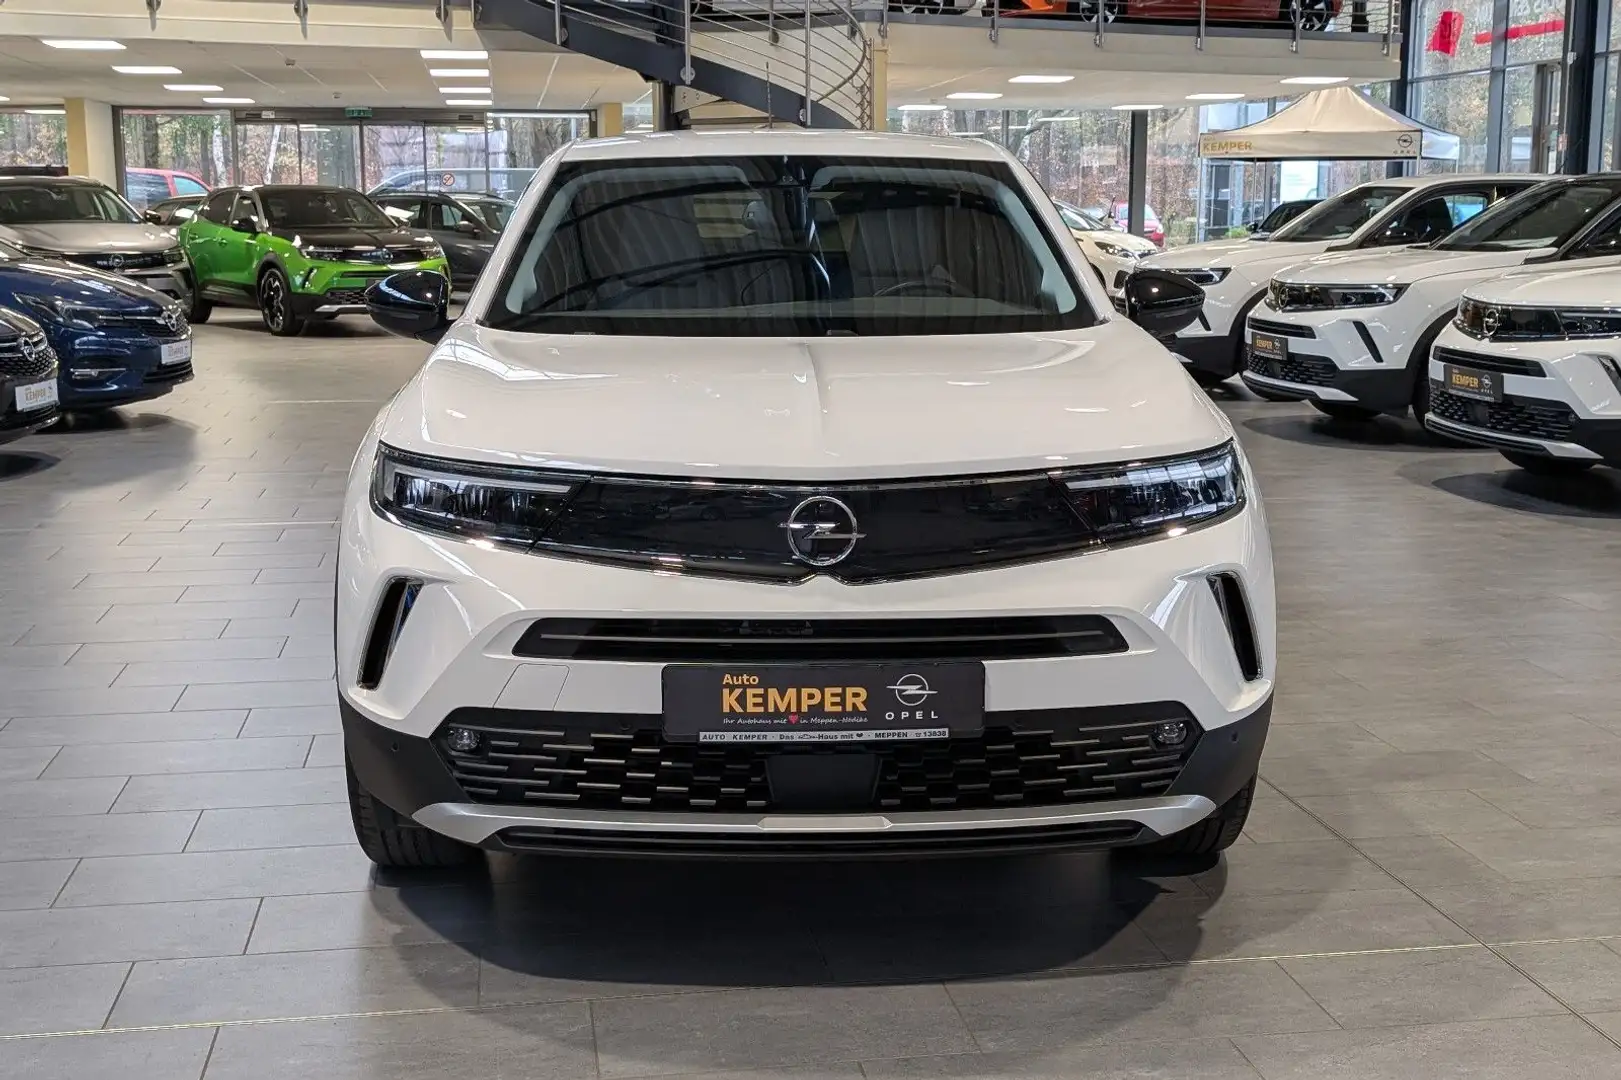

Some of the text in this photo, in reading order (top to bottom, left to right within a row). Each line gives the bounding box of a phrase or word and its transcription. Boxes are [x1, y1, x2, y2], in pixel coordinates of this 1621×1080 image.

[1203, 141, 1253, 151] KEMPER
[722, 673, 759, 685] Auto
[722, 686, 868, 713] KEMPER
[737, 717, 772, 725] Autohaus
[885, 710, 939, 721] OPEL
[701, 733, 726, 741] AUTO
[732, 733, 768, 741] KEMPER
[874, 731, 908, 739] MEPPEN
[922, 730, 947, 738] 13838
